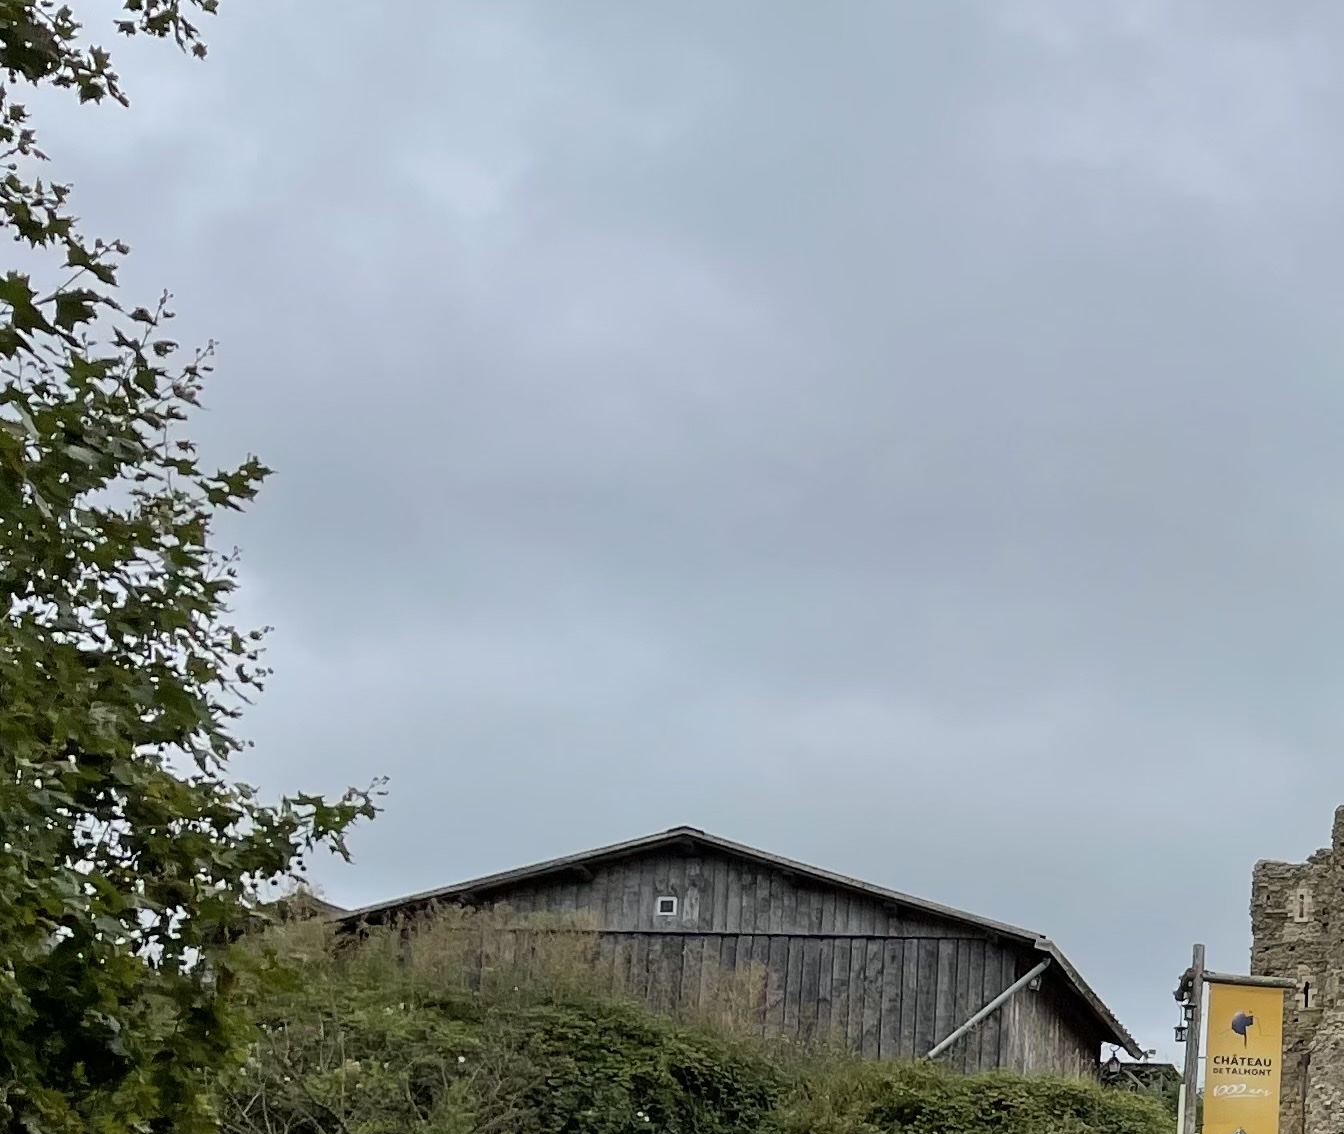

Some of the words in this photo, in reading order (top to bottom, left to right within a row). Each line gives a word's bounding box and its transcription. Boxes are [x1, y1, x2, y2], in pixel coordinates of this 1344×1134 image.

[1213, 1054, 1272, 1067] CHÂTEAU
[1225, 1067, 1272, 1077] TALMONT
[1213, 1083, 1247, 1097] 1000
